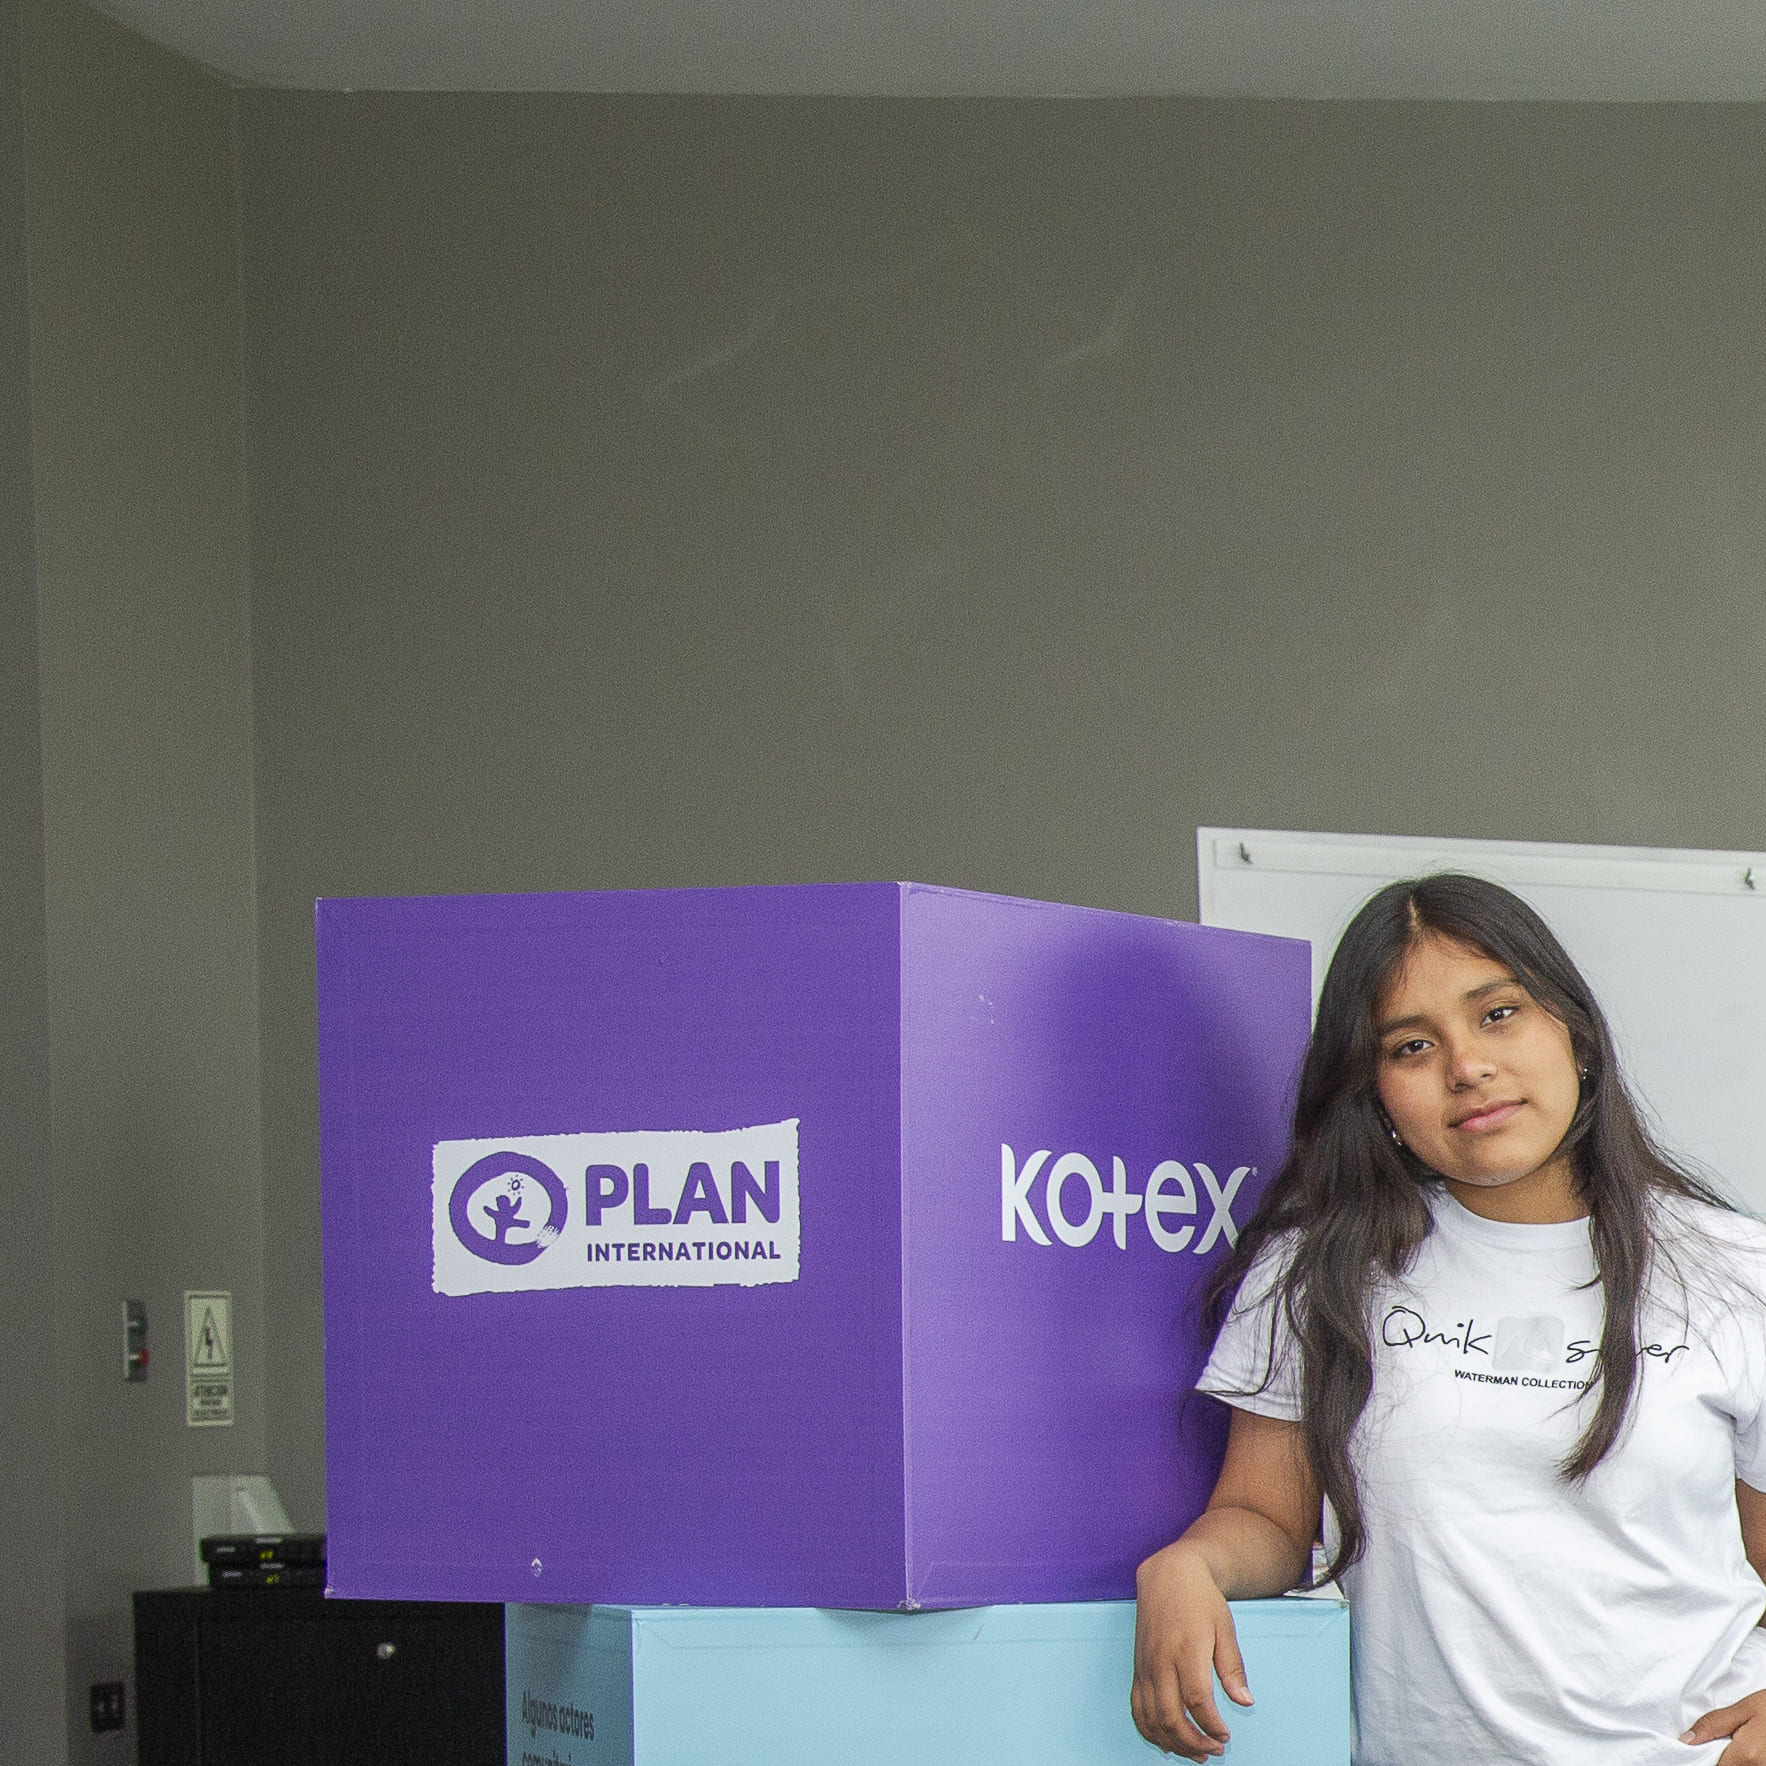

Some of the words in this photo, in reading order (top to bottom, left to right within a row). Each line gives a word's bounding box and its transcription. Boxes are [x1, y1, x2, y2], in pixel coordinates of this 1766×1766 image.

[585, 1160, 781, 1227] PLAN
[586, 1241, 781, 1263] INTERNATIONAL
[1454, 1369, 1519, 1386] WATERMAN
